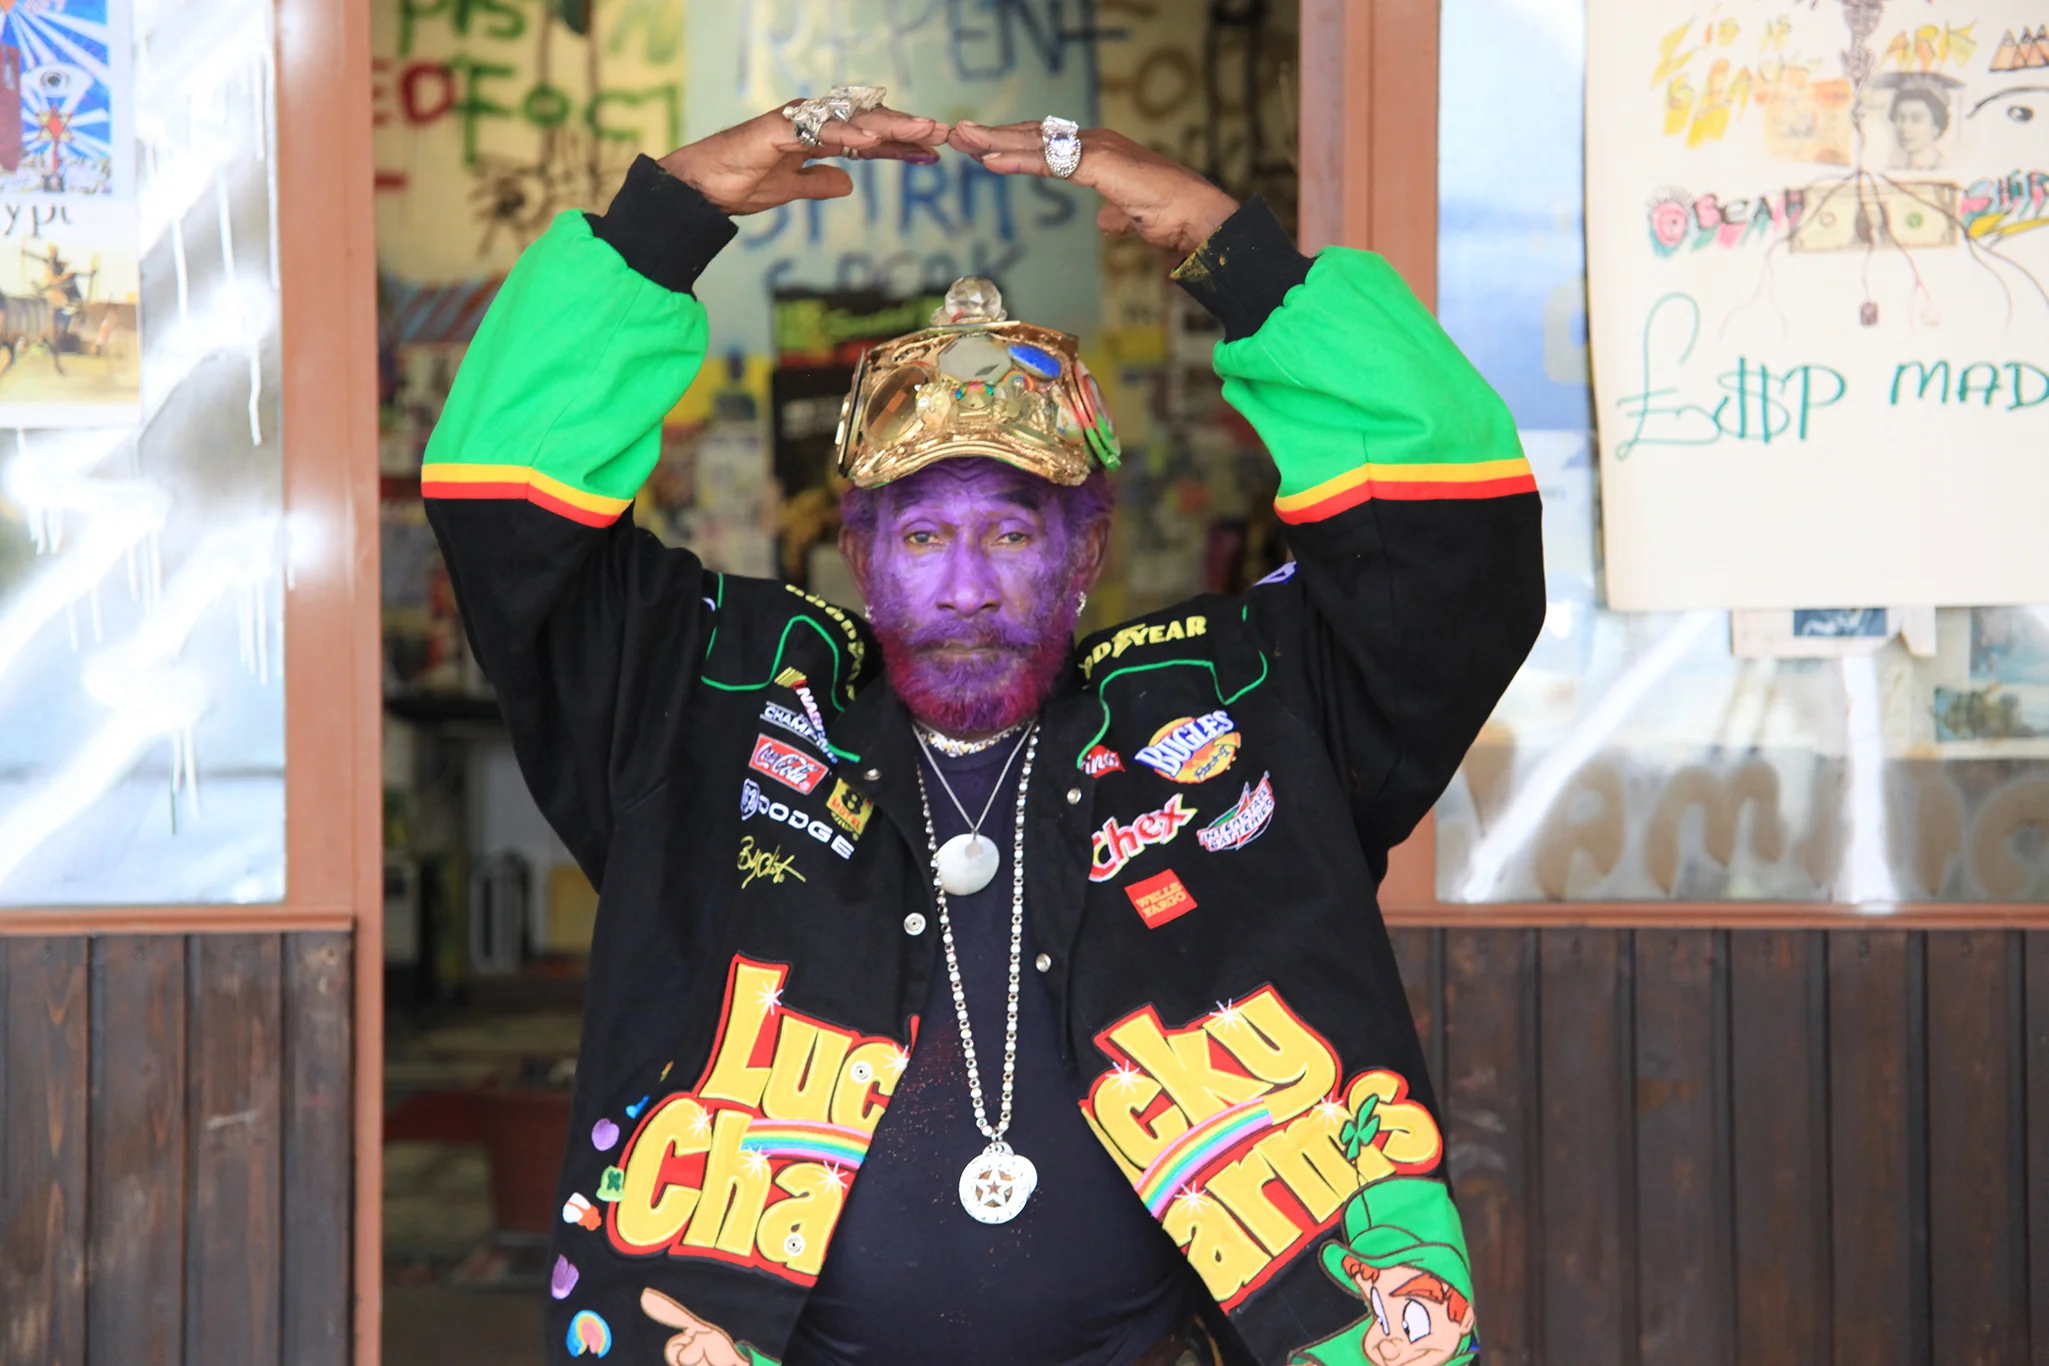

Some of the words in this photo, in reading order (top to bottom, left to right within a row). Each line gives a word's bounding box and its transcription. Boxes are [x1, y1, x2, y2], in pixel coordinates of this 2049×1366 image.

[1880, 19, 1977, 73] ARK
[1890, 360, 2049, 411] MAD
[1133, 710, 1235, 778] BUGLES
[758, 794, 855, 860] DODGE
[1089, 792, 1198, 883] Chex
[1202, 785, 1269, 842] INTERSTATE
[1210, 798, 1273, 849] BATTERIES
[1135, 881, 1182, 909] WELLS
[1142, 891, 1187, 919] FARGO
[612, 1096, 848, 1277] Cha
